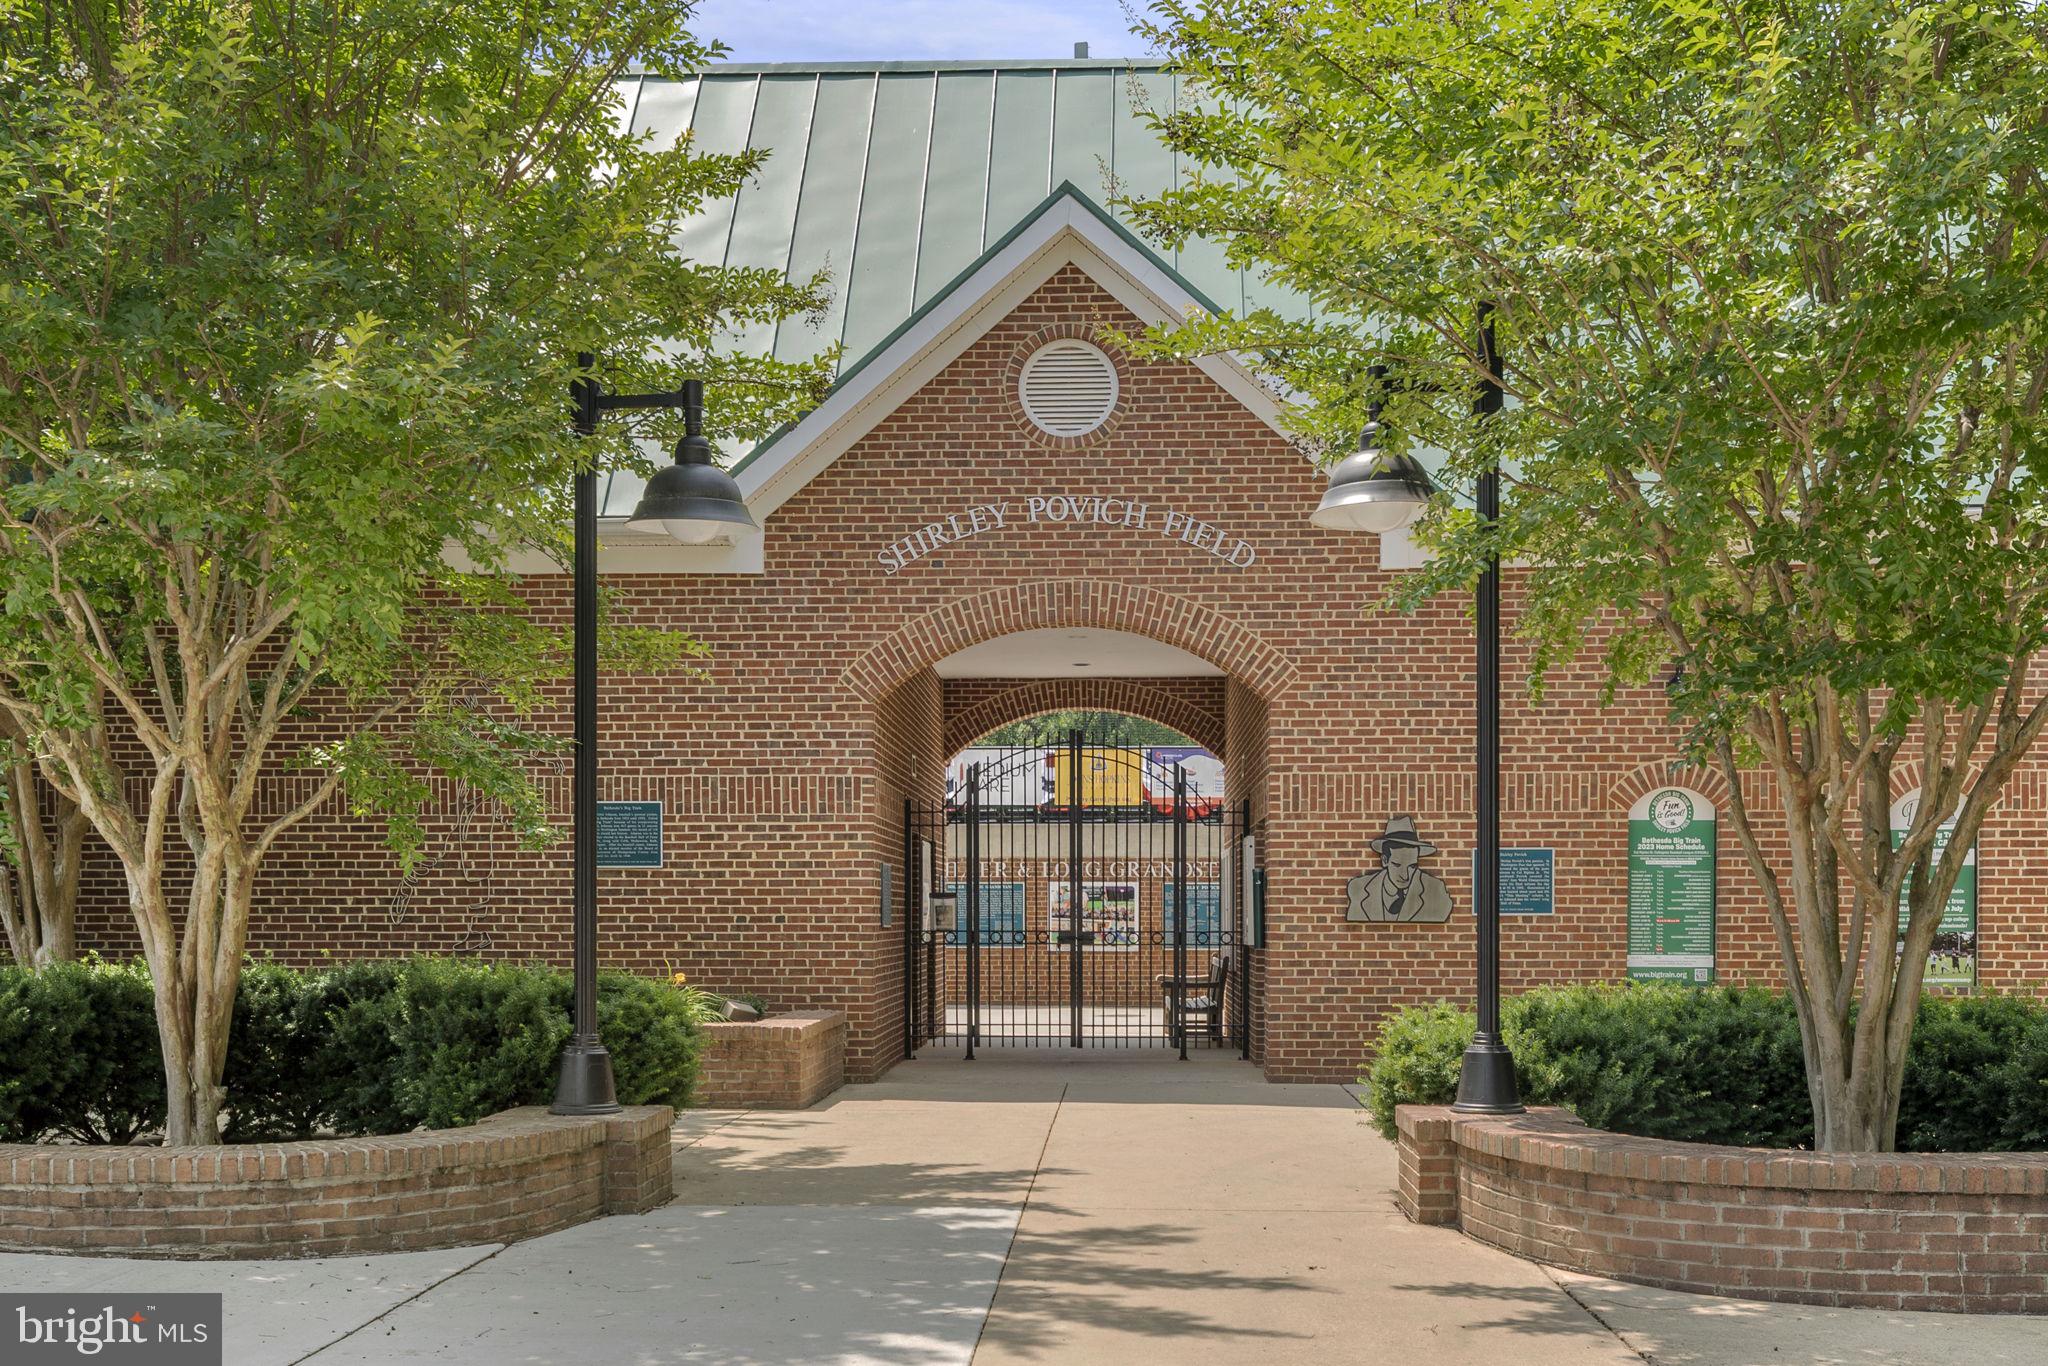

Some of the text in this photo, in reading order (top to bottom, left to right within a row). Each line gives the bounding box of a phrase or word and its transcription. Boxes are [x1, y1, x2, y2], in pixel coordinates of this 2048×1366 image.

[877, 495, 1257, 576] SHIRLEY POVICH FIELD
[979, 762, 1036, 777] EDIUM
[978, 778, 1010, 792] ARE
[1663, 800, 1680, 811] Fun
[1657, 809, 1686, 819] is Good!
[1673, 837, 1684, 845] Big
[1017, 861, 1031, 878] &
[1043, 861, 1102, 878] LOG
[1633, 971, 1688, 979] www.bigtrain.org
